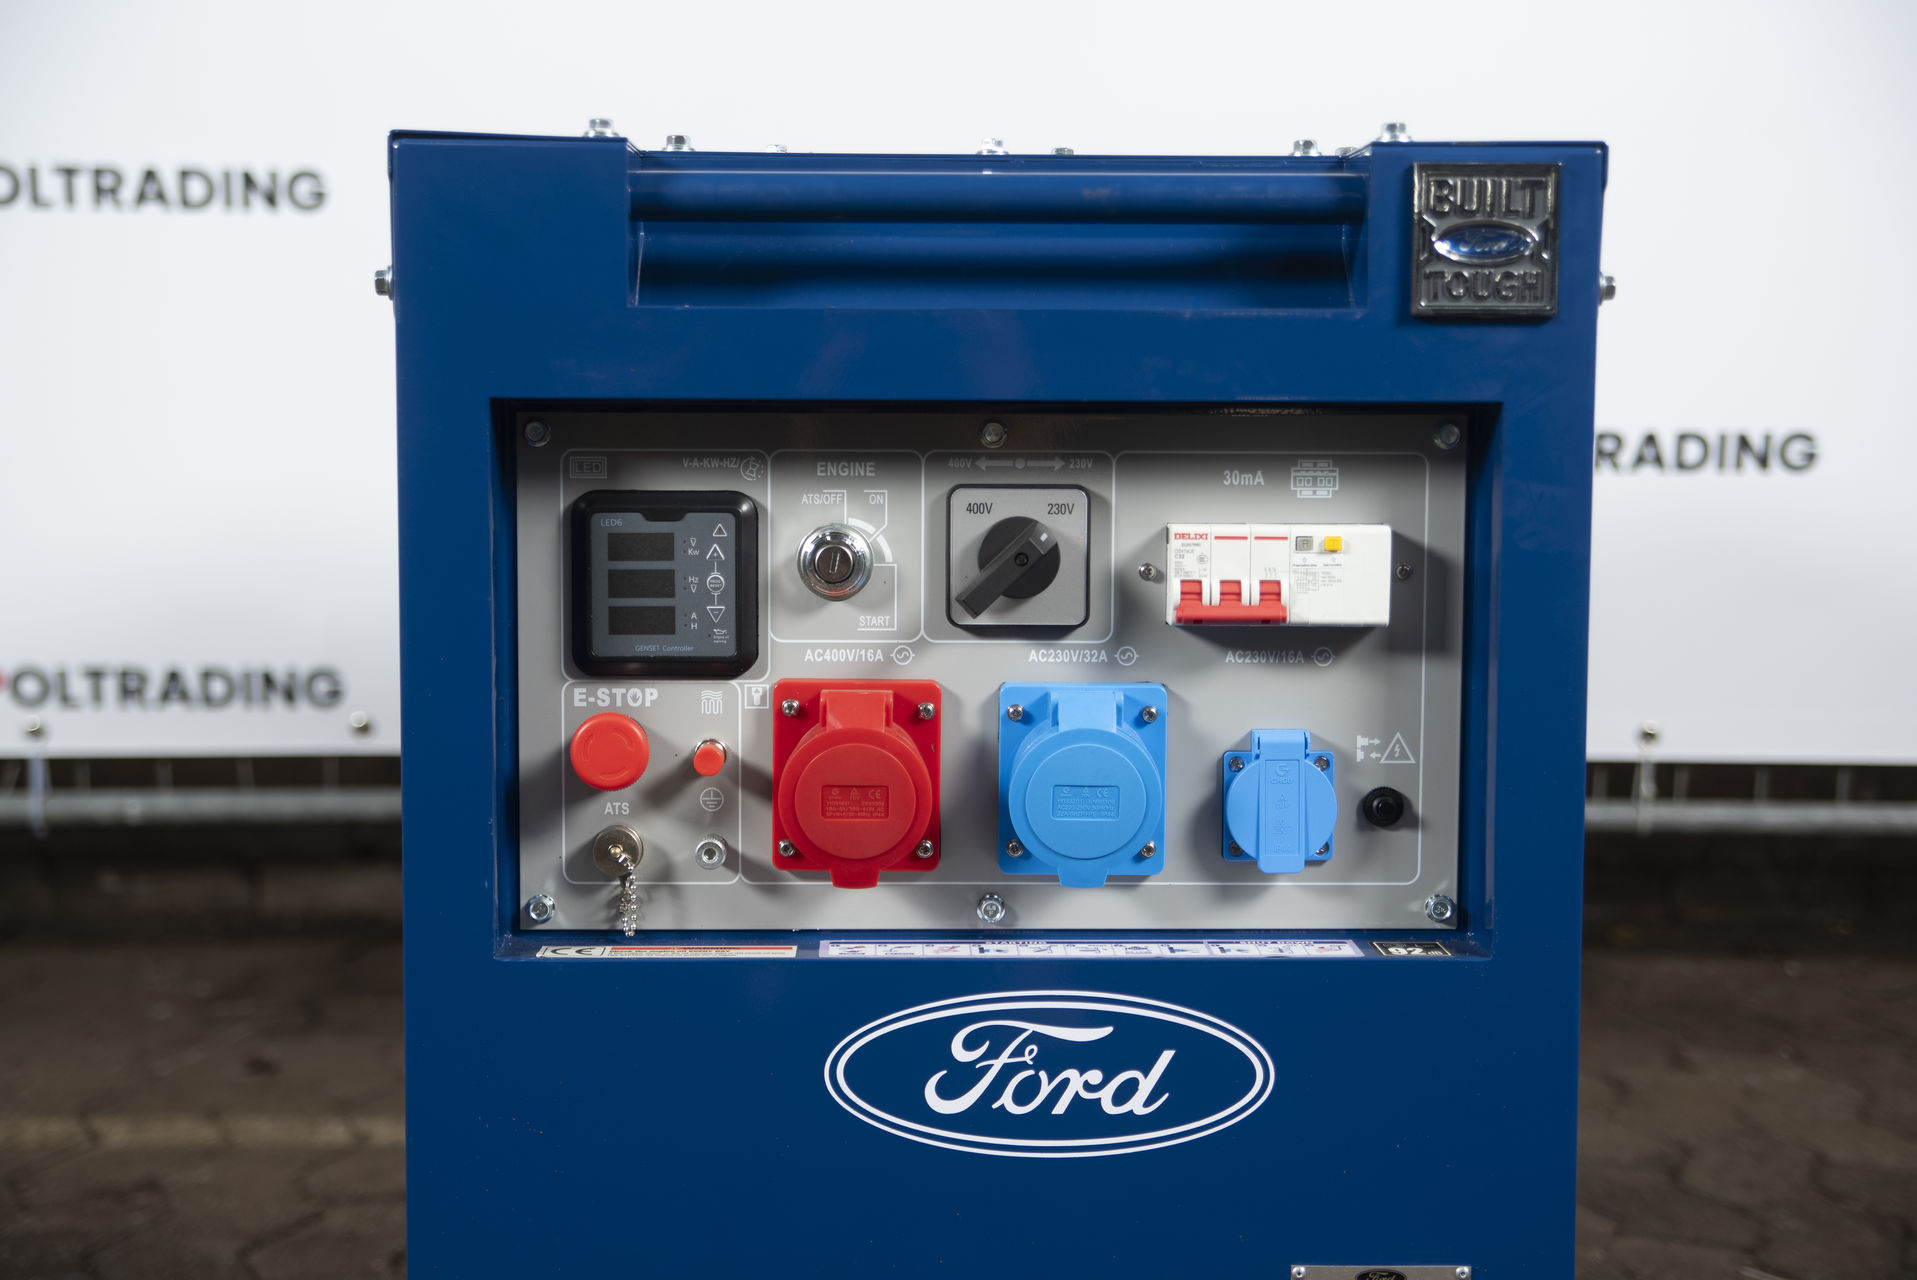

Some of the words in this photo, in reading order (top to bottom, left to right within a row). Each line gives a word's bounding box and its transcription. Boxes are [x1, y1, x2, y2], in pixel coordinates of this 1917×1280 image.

[1429, 178, 1546, 218] BUILT
[1422, 269, 1542, 300] TOUGH
[575, 462, 601, 473] LED
[816, 463, 876, 477] ENGINE
[948, 458, 973, 469] 400V
[1068, 458, 1094, 469] 230V
[1223, 471, 1265, 487] 30mA
[802, 494, 843, 505] ATS/OFF
[869, 494, 884, 505] ON
[966, 502, 993, 515] 400V
[1047, 502, 1075, 516] 230V
[600, 518, 623, 527] LED6
[1174, 532, 1209, 541] DELIXI
[689, 576, 698, 584] Hz
[691, 612, 697, 620] A
[859, 617, 891, 627] START
[691, 622, 697, 630] H
[635, 645, 660, 653] GENSET
[663, 645, 695, 653] Controller
[804, 650, 884, 664] AC400V/16A
[1028, 650, 1108, 664] AC230V/32A
[1225, 650, 1305, 664] AC230V/16A
[0, 668, 345, 708] OLTRADING
[573, 688, 658, 707] E-STOP
[604, 802, 630, 816] ATS
[924, 1019, 1176, 1115] Ford
